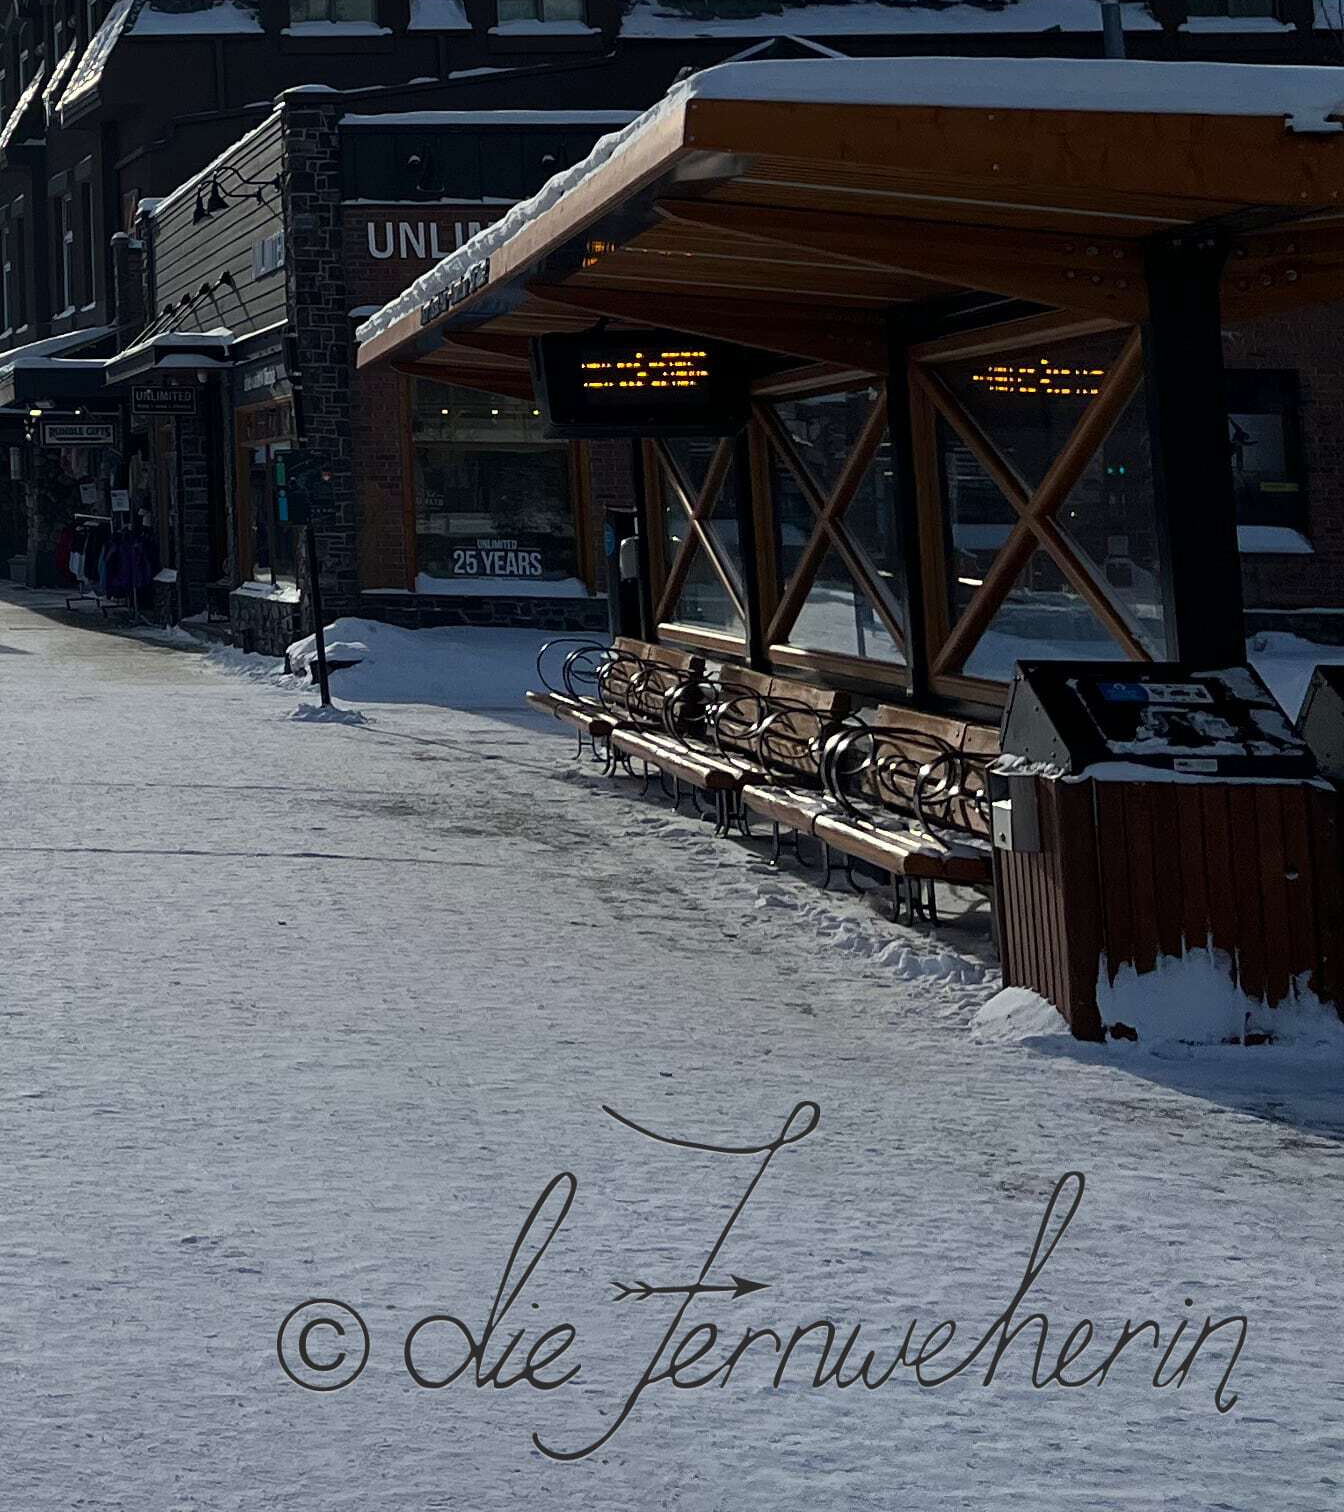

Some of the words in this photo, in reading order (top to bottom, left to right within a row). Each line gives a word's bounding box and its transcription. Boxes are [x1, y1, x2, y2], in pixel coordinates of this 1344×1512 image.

[136, 391, 192, 401] UNLIMITED
[476, 538, 518, 550] UNLIMITED
[453, 550, 479, 574] 25
[480, 551, 543, 576] YEARS
